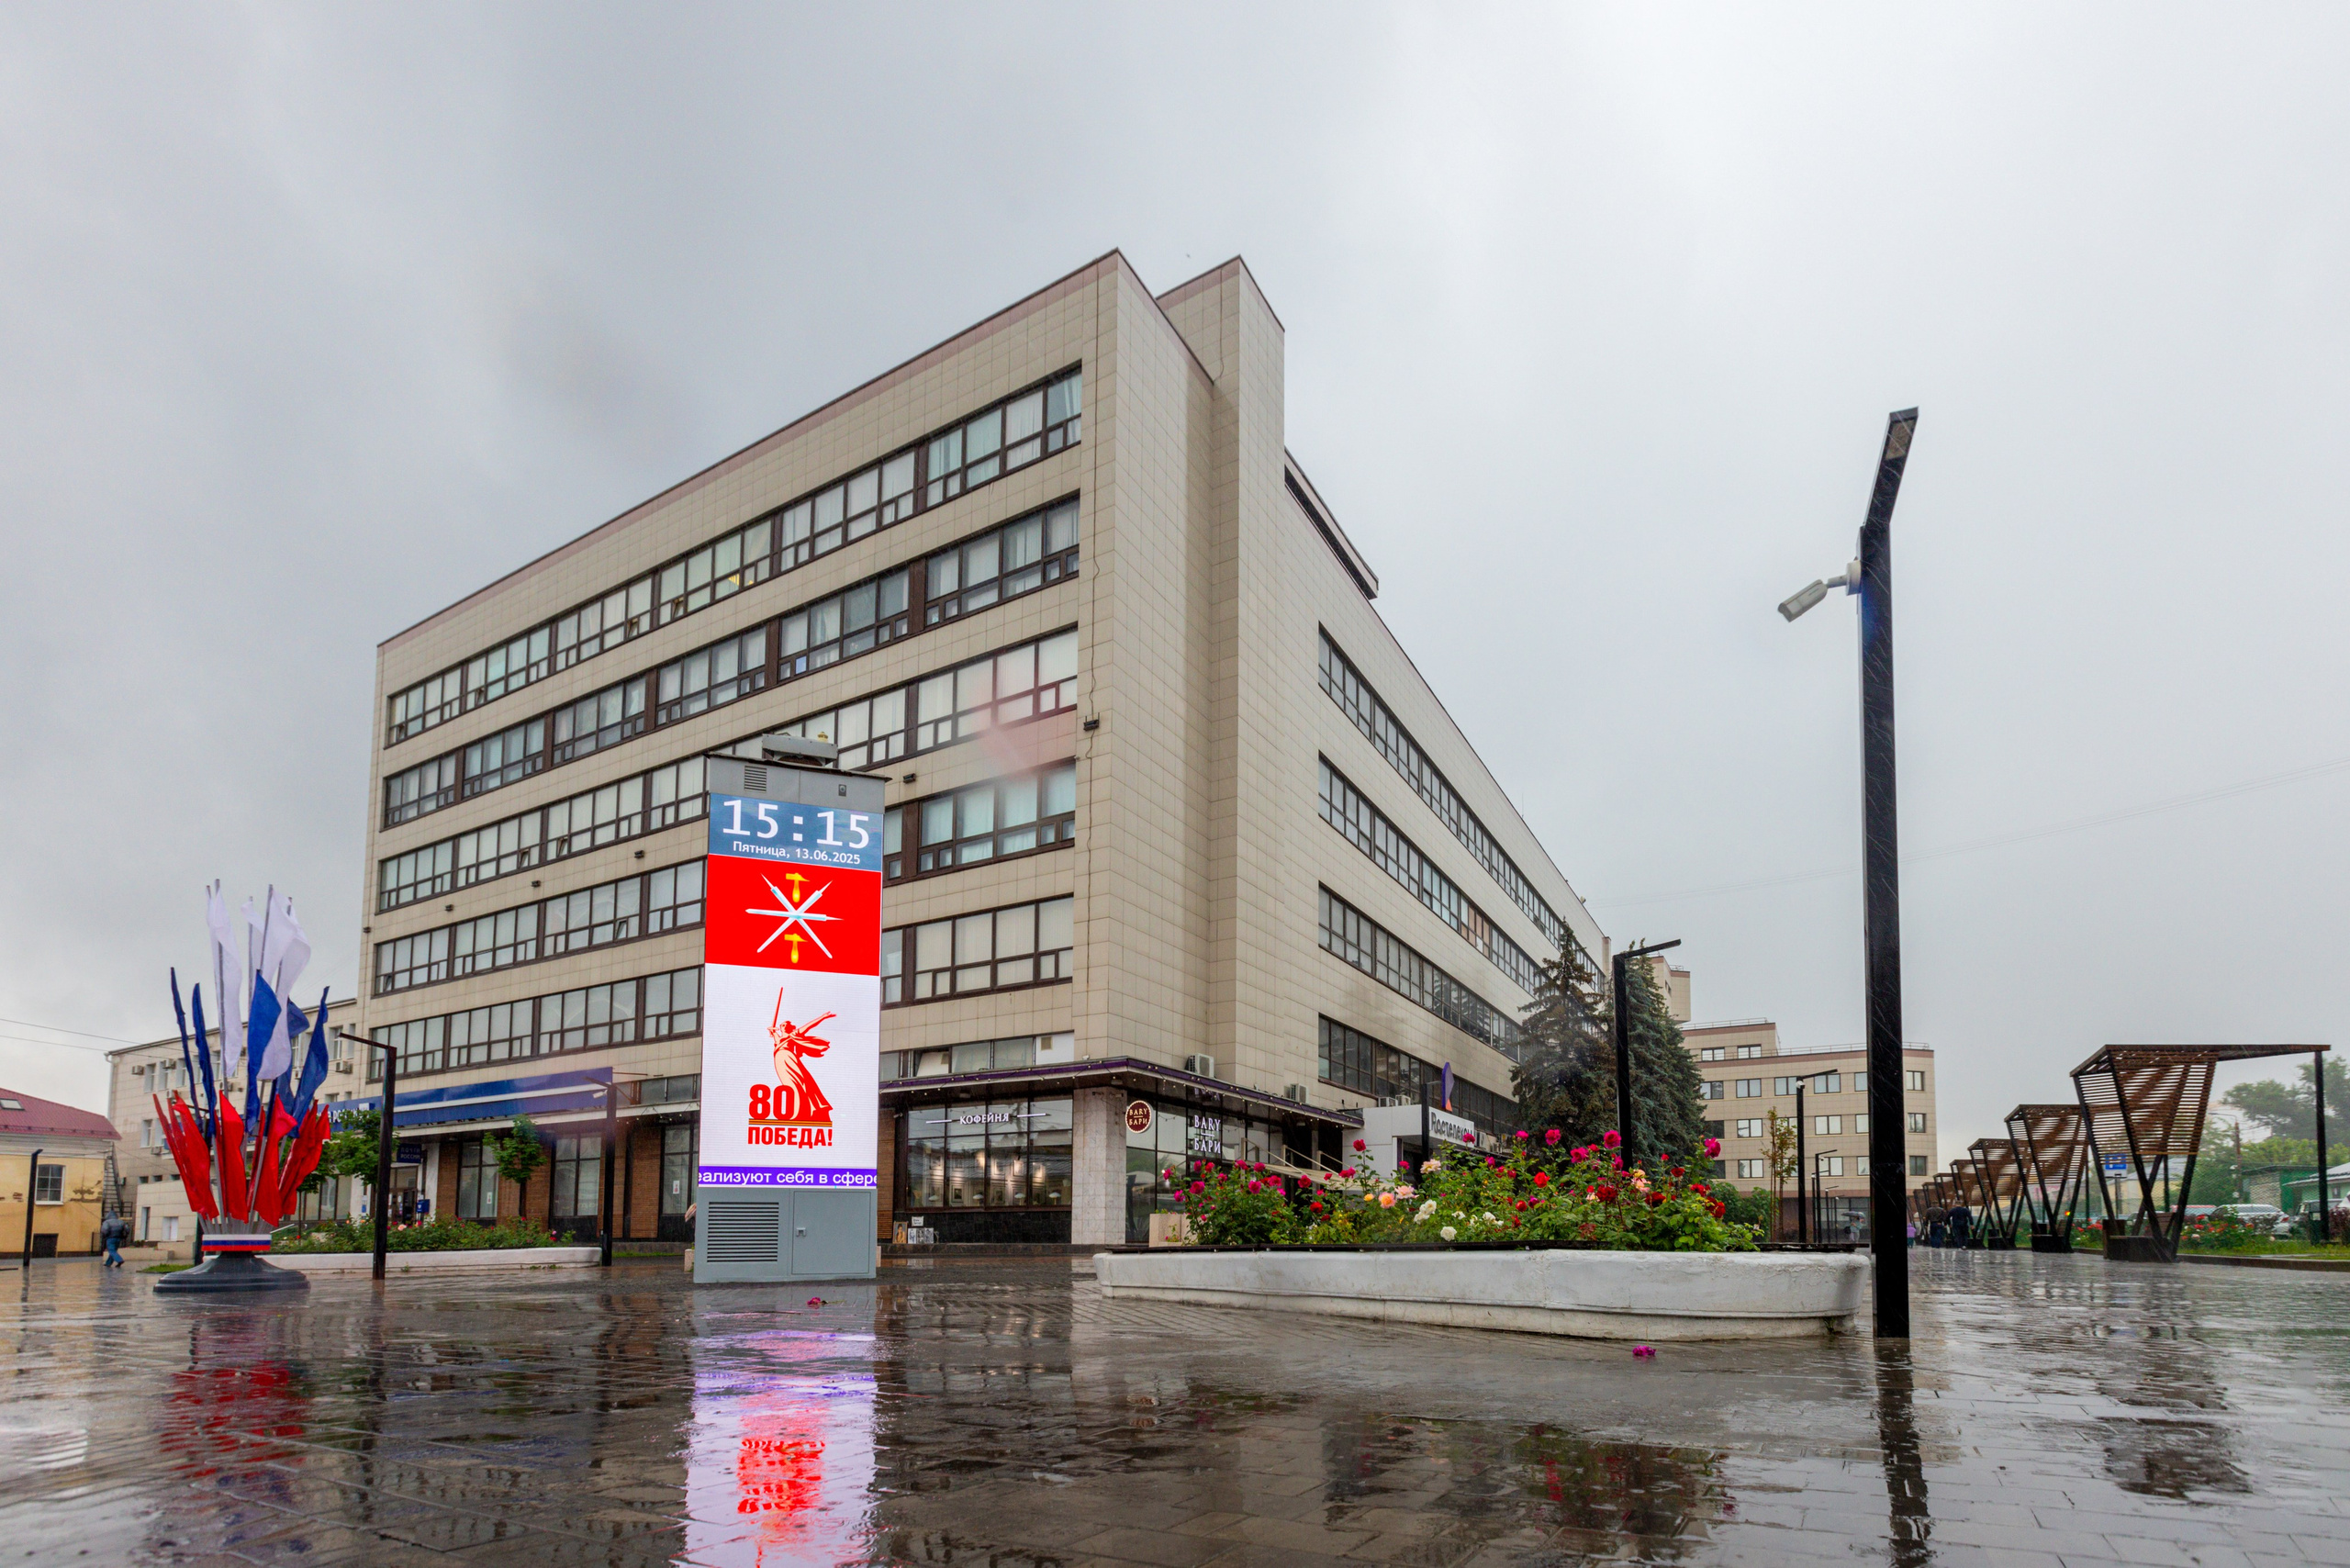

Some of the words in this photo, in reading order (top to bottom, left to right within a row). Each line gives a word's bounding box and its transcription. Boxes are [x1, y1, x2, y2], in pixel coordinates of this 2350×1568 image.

[722, 800, 869, 849] 15:15
[733, 841, 790, 857] Пятница,
[795, 849, 861, 865] 13.06.2025
[748, 1084, 795, 1119] 80
[959, 1112, 1010, 1125] КОФЕЙНЯ
[1129, 1108, 1147, 1116] BARY
[1193, 1114, 1221, 1132] BARY
[747, 1126, 833, 1148] ПОБЕДА!
[1193, 1138, 1221, 1154] БАРИ
[777, 1170, 813, 1183] себя
[819, 1173, 828, 1183] в
